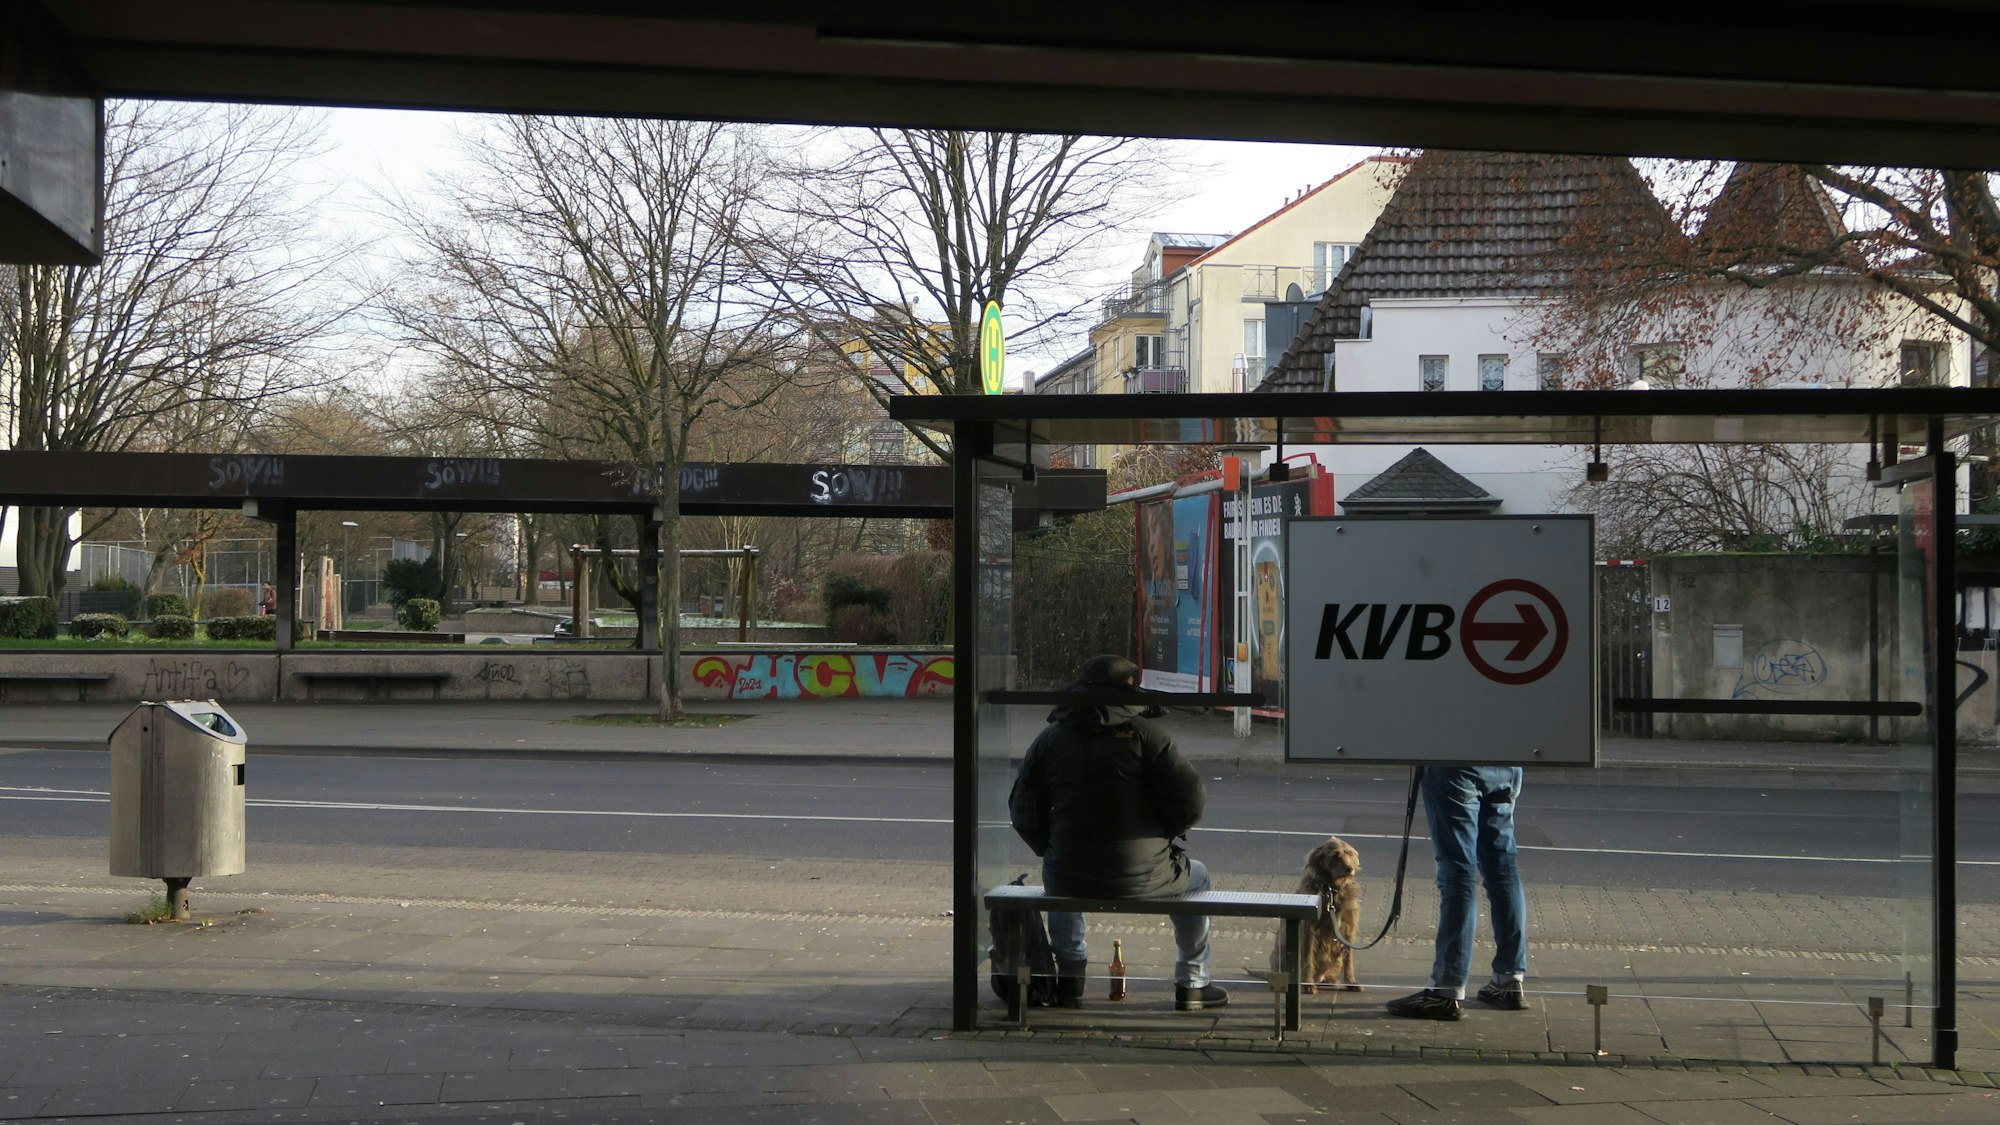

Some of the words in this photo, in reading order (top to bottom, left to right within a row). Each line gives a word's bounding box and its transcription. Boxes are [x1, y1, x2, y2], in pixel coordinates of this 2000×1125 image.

[1263, 496, 1272, 514] ES
[1259, 518, 1281, 537] FINDEN
[1315, 603, 1456, 660] KVB
[141, 658, 220, 696] Antifa
[738, 678, 762, 694] 2021
